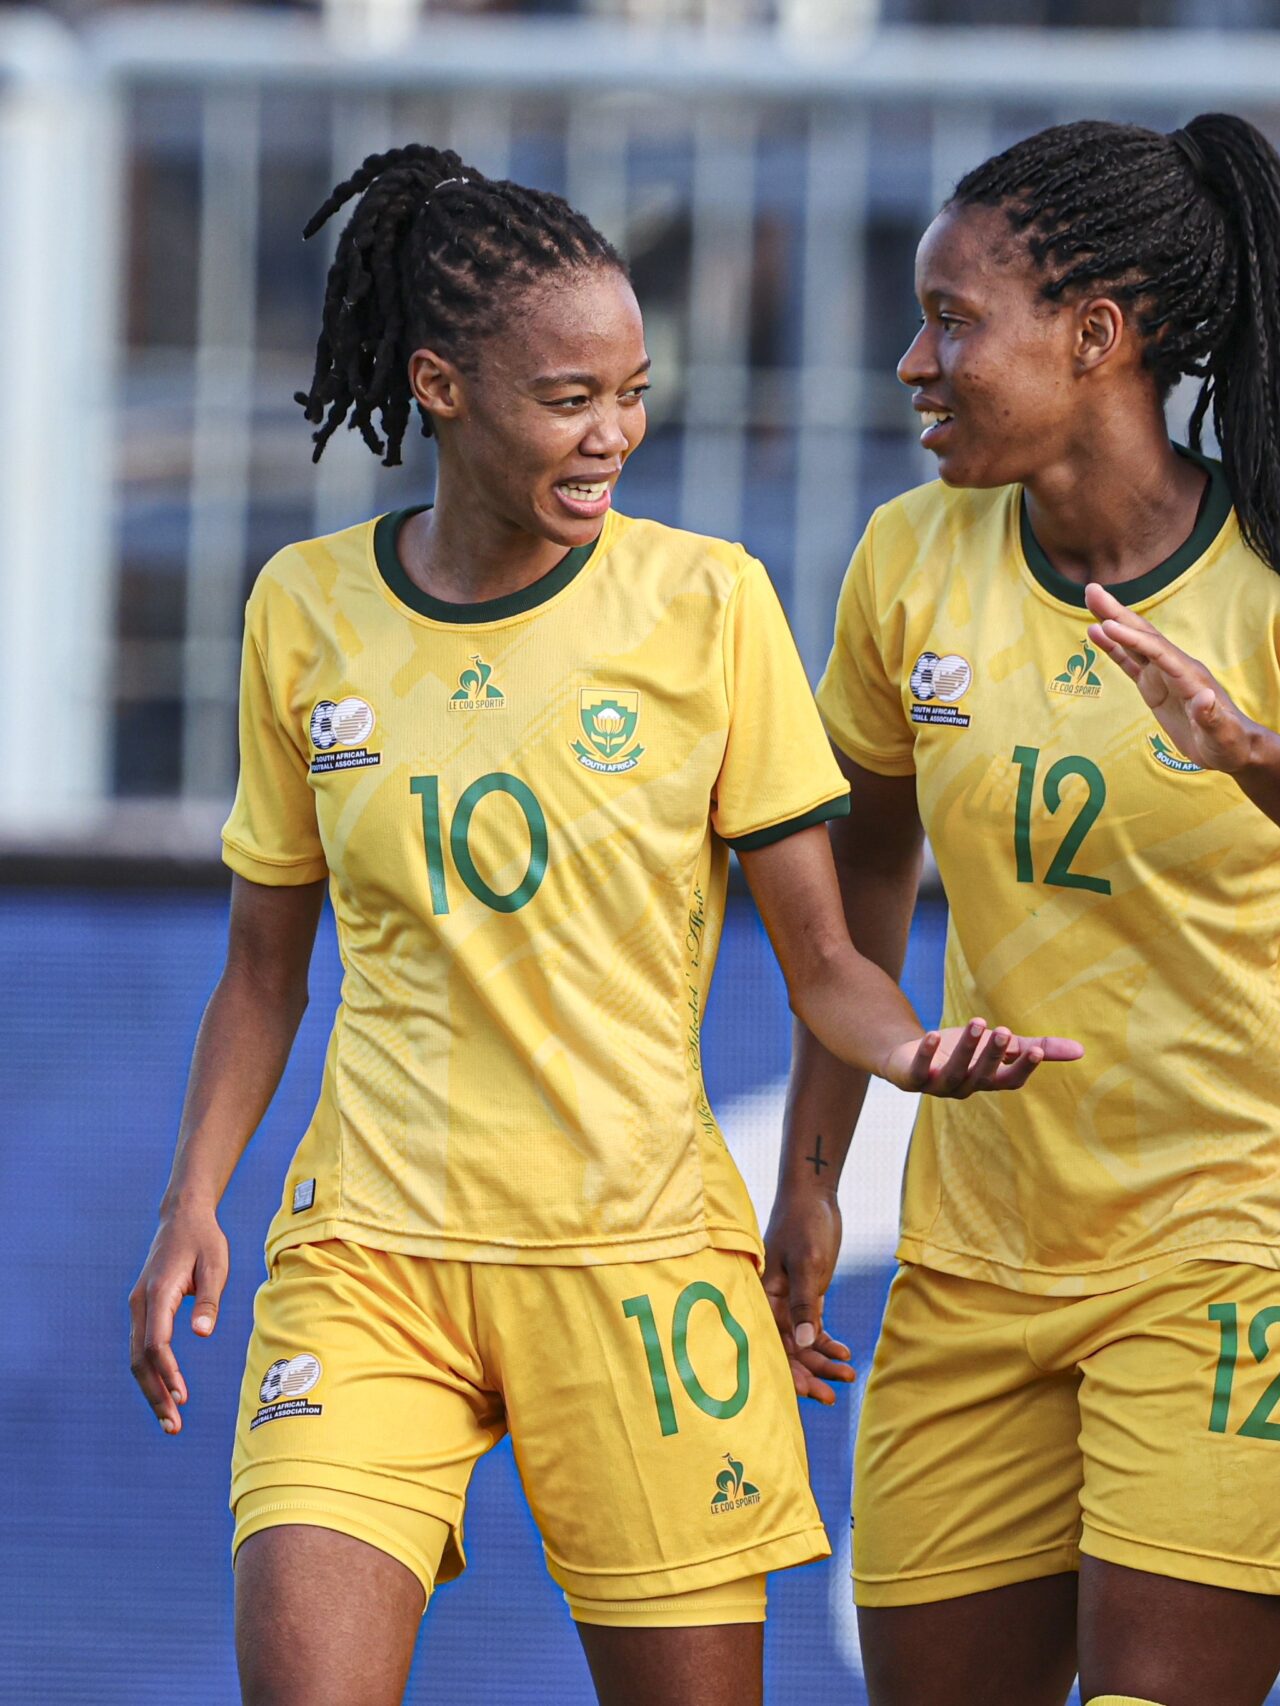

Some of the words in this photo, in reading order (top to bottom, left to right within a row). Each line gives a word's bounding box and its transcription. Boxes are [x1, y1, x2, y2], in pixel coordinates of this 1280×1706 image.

[449, 701, 457, 710] LE
[459, 700, 474, 709] COQ
[475, 698, 505, 709] SPORTIF
[931, 707, 957, 716] AFRICAN
[929, 715, 969, 725] ASSOCIATION
[316, 754, 335, 763] SOUTH
[336, 750, 366, 761] AFRICAN
[335, 756, 379, 769] ASSOCIATION
[580, 755, 606, 771] SOUTH
[607, 759, 636, 772] AFRICA
[1156, 751, 1182, 769] SOUTH
[1012, 745, 1112, 895] 12
[410, 771, 549, 915] 10
[622, 1281, 750, 1437] 10
[258, 1406, 277, 1416] SOUTH
[277, 1400, 306, 1411] AFRICAN
[274, 1407, 321, 1418] ASSOCIATION
[711, 1504, 720, 1514] LE
[720, 1500, 735, 1512] COQ
[735, 1494, 761, 1509] SPORTIF
